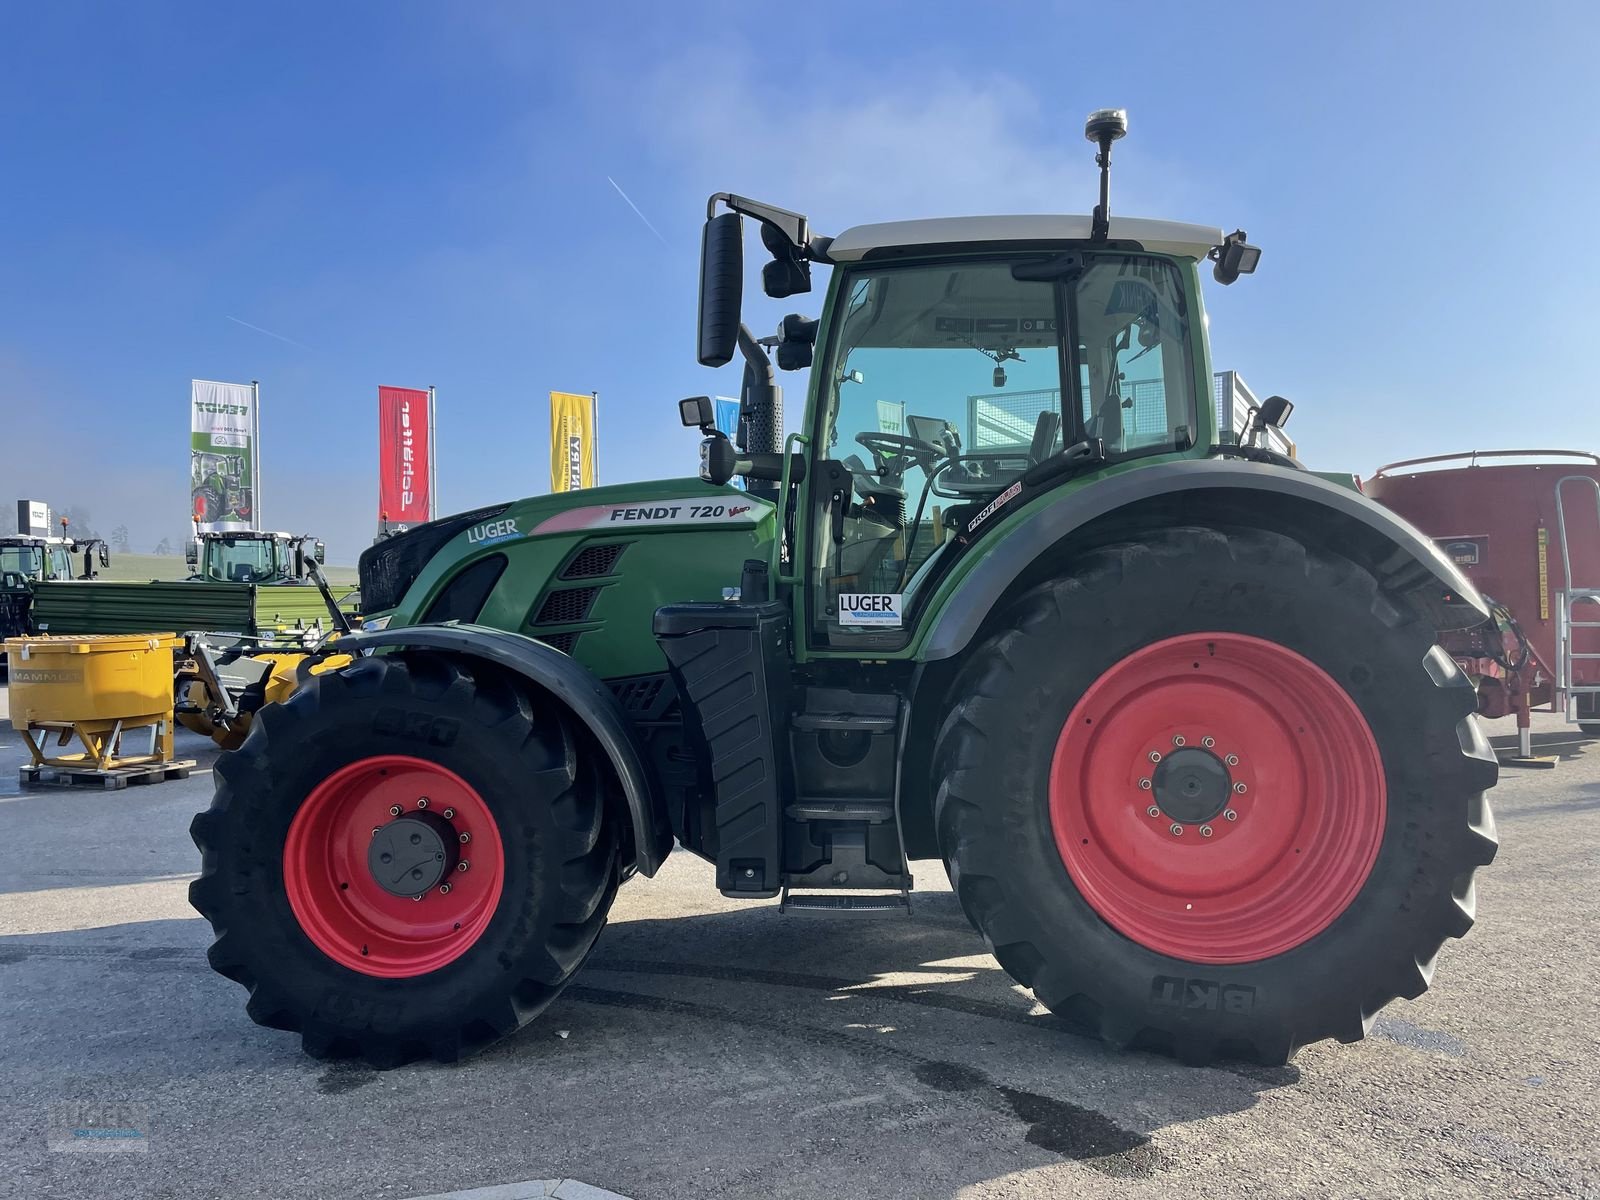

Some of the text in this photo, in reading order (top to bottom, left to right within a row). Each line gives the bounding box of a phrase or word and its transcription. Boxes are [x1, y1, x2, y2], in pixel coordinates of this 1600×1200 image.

[610, 507, 681, 521] FENDT
[690, 506, 724, 518] 720
[969, 501, 997, 530] PROFI
[467, 518, 519, 544] LUGER
[840, 595, 893, 612] LUGER
[1152, 982, 1254, 1014] BKT
